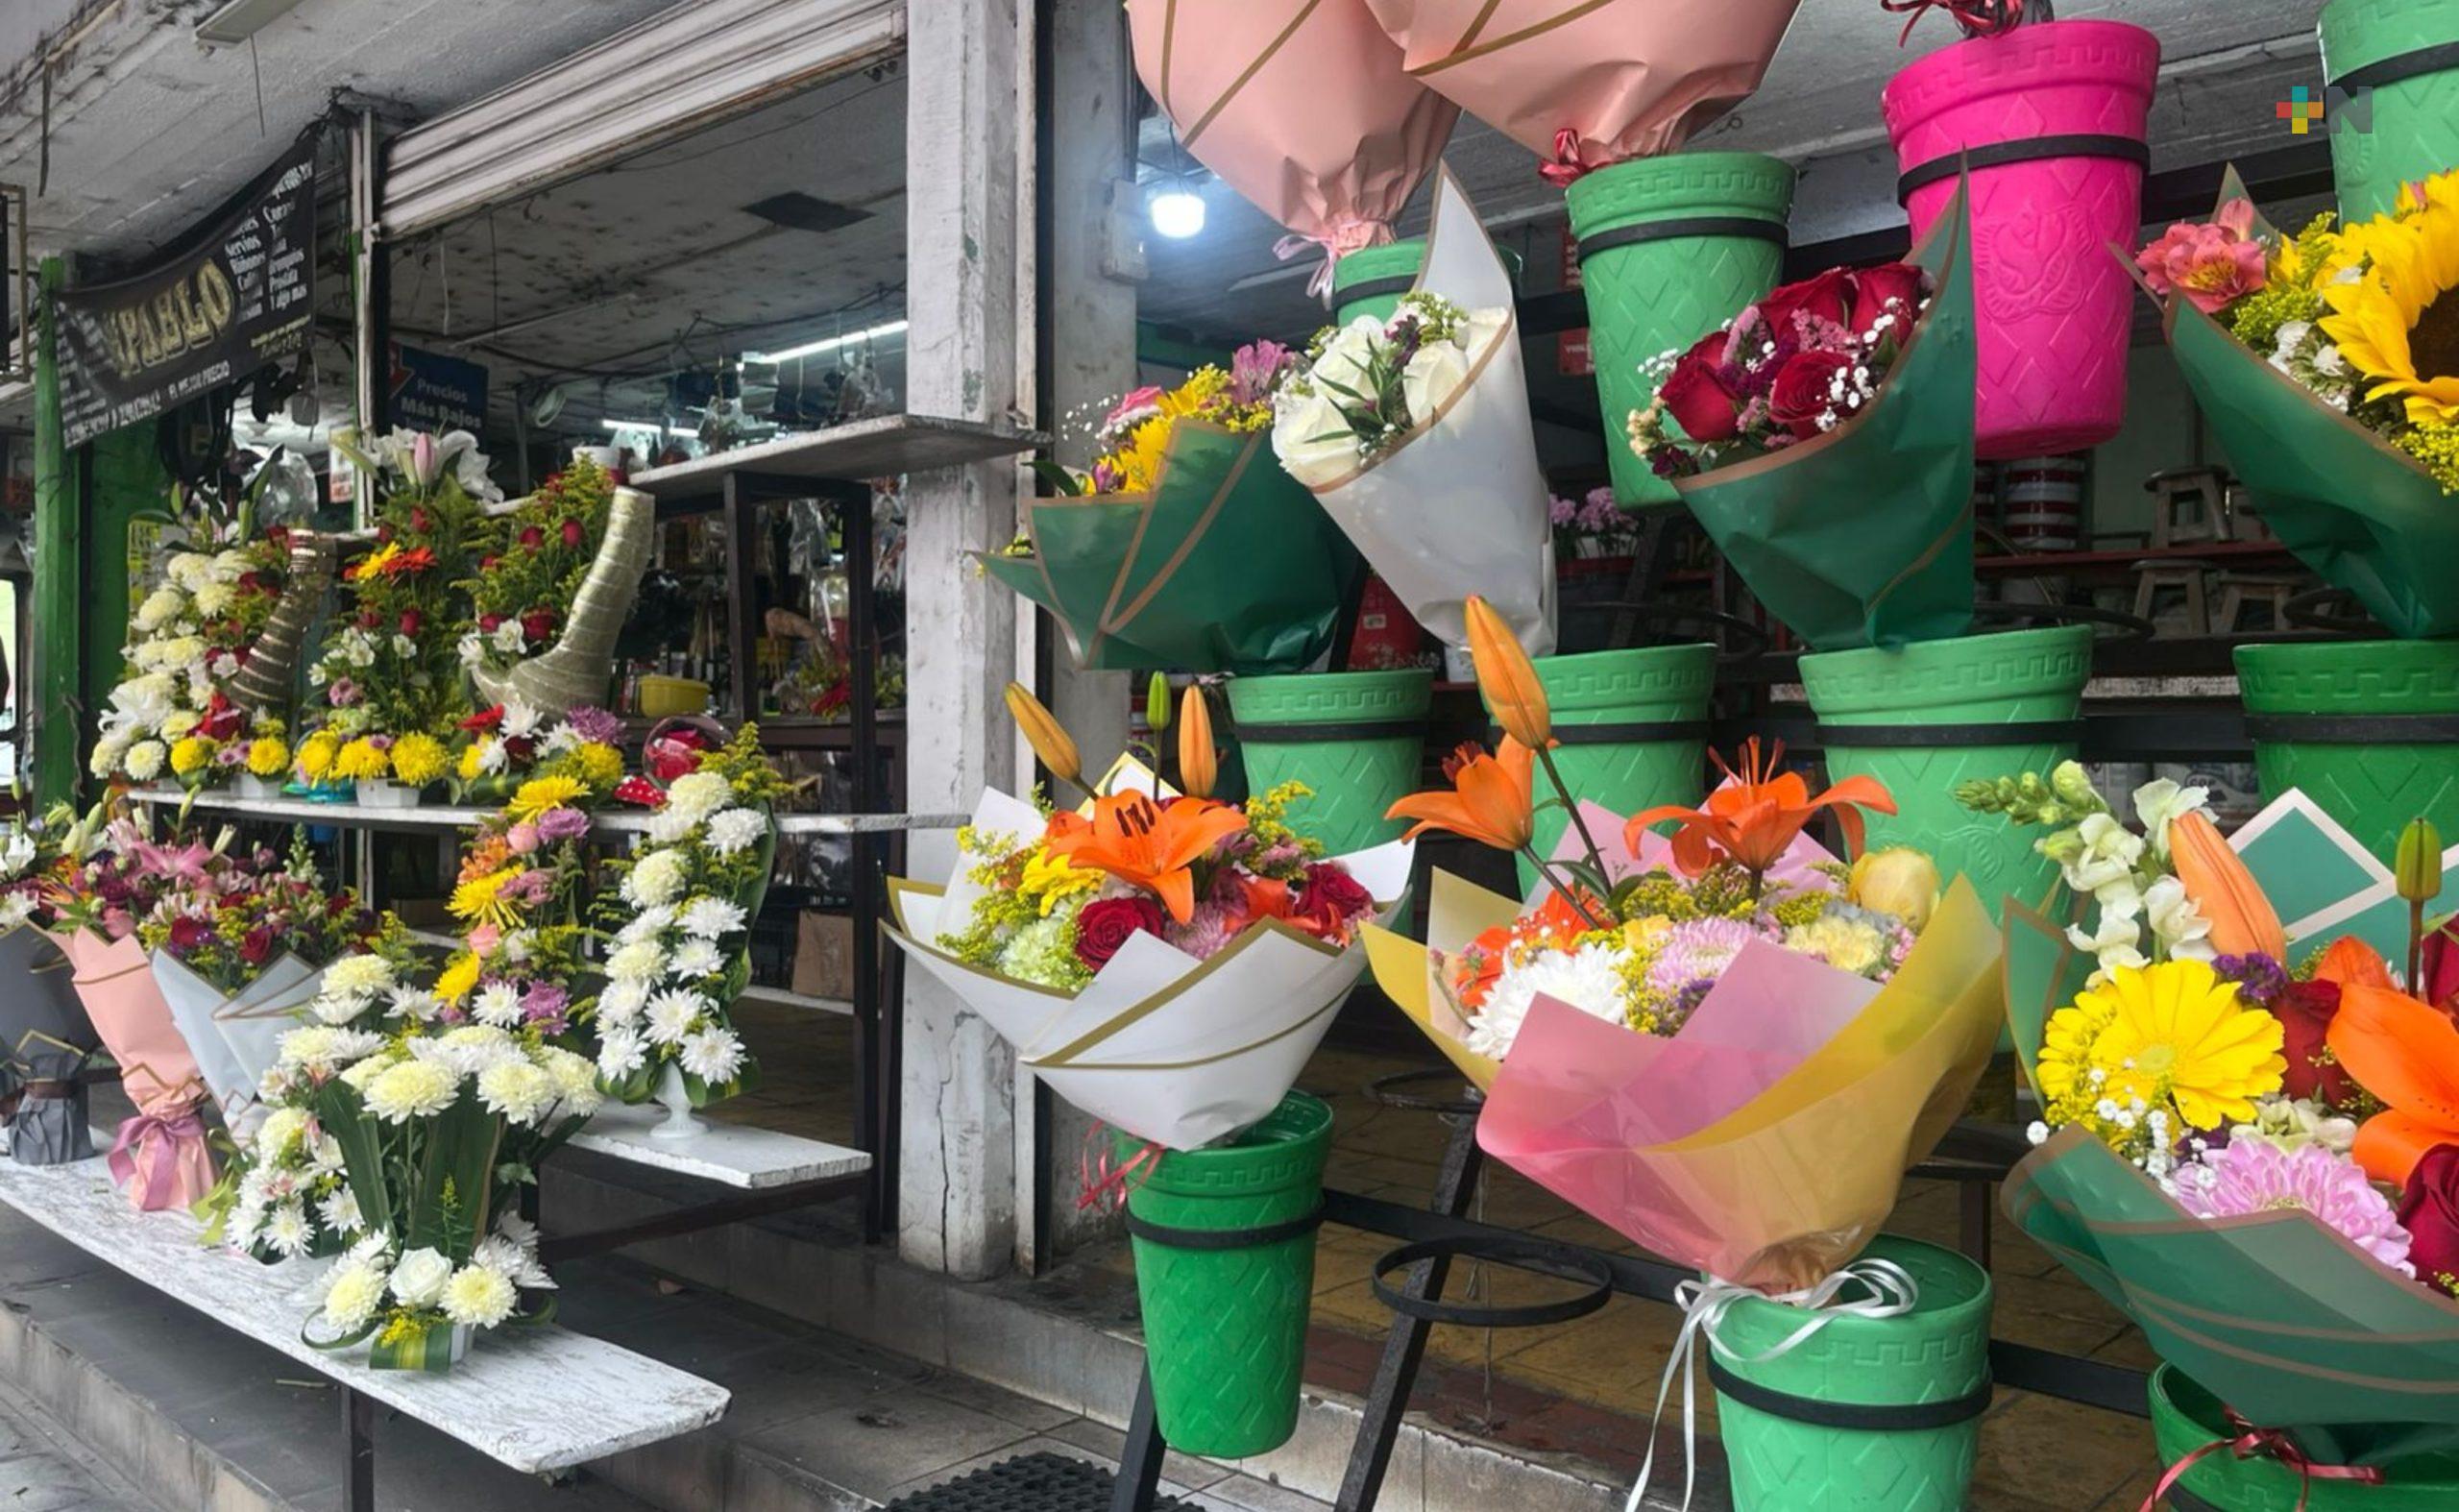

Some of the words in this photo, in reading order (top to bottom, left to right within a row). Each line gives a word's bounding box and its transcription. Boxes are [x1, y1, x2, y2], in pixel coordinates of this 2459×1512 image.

[417, 378, 468, 402] Precios
[401, 397, 436, 418] Más
[438, 404, 482, 429] Bajos
